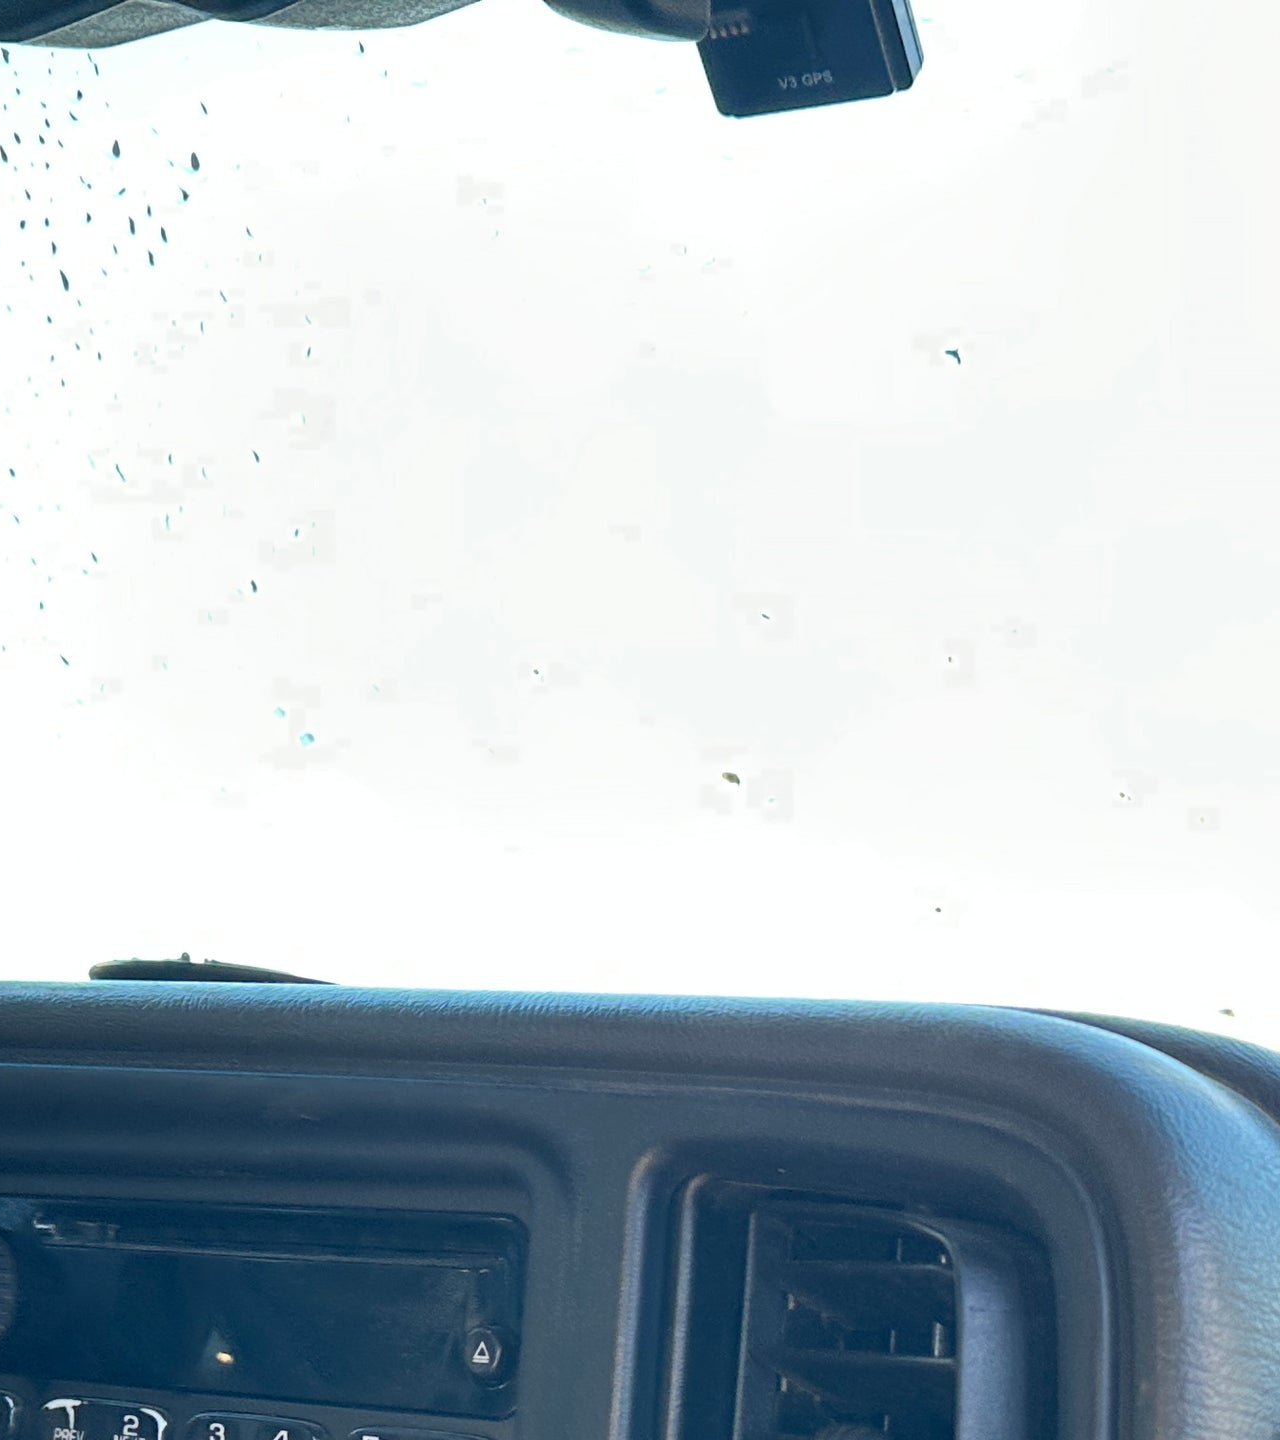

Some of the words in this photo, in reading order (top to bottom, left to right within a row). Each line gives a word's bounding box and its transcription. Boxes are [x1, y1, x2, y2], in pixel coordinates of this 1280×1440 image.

[778, 77, 798, 90] V3
[801, 70, 834, 86] GPS
[122, 1413, 141, 1437] 2
